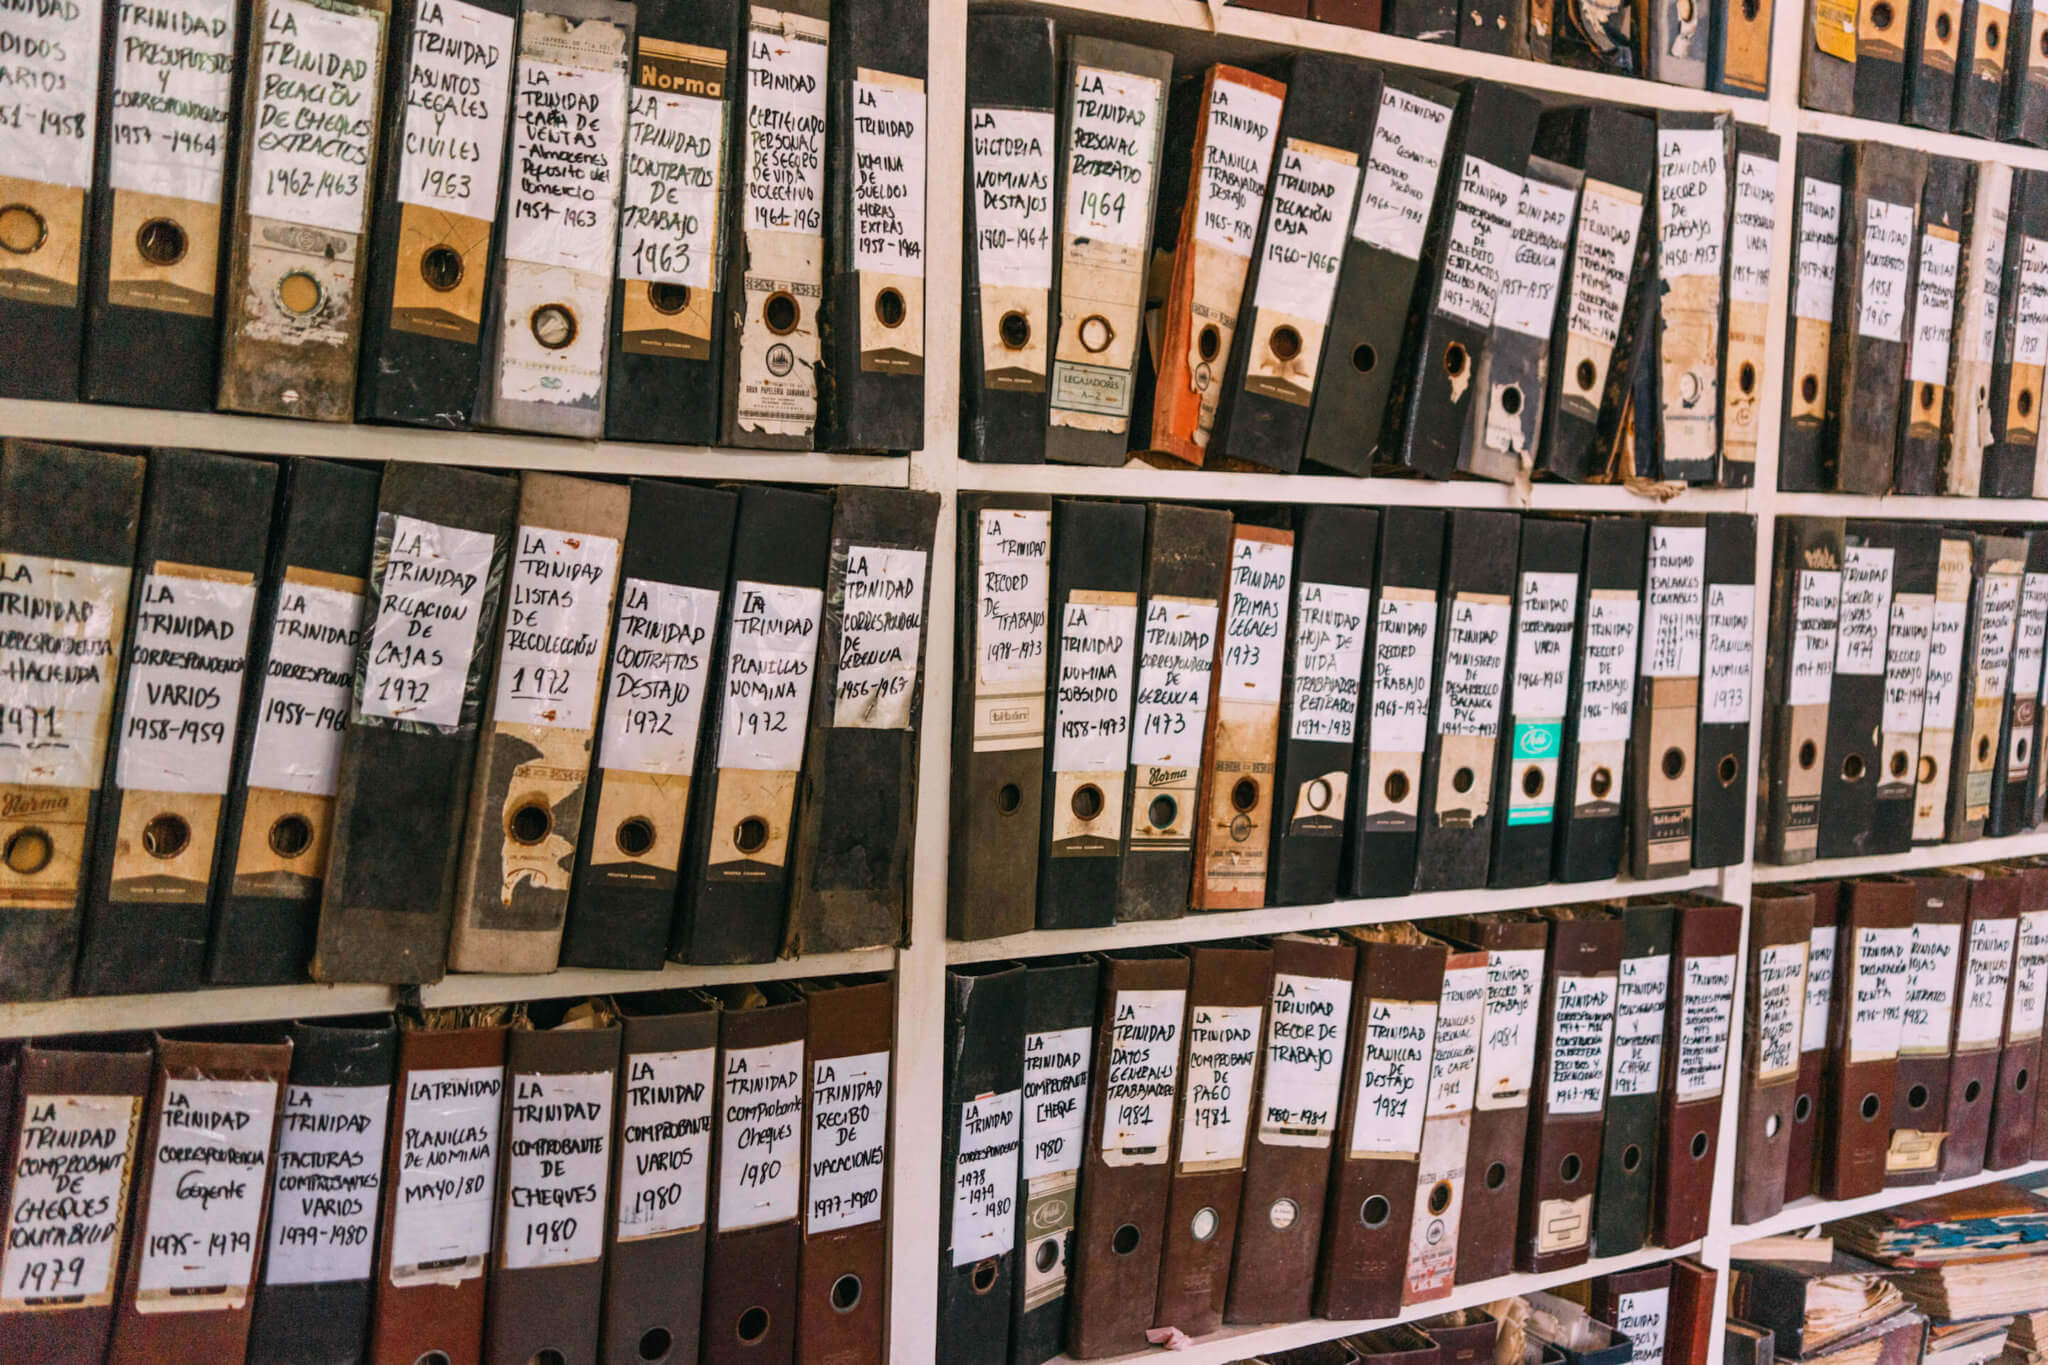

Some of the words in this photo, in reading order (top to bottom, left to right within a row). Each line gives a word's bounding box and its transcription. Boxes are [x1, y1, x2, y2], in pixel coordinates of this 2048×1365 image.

[413, 30, 500, 69] TRINIDAD
[263, 41, 368, 82] TRINIDAD
[158, 70, 171, 94] Y
[411, 64, 481, 97] ASUNTOS
[642, 65, 721, 97] Norma
[747, 69, 816, 93] TRINIDAD
[407, 89, 489, 120] LEGALES
[521, 90, 600, 112] TRINIDAD
[1212, 91, 1228, 105] LA
[259, 104, 288, 130] DE
[1077, 100, 1146, 126] TRINIDAD
[1400, 97, 1447, 124] TRINIDAD
[434, 112, 446, 137] Y
[855, 117, 914, 138] TRINIDAD
[1210, 110, 1268, 141] TRINIDAD
[405, 132, 481, 163] CIVILES
[527, 127, 597, 149] VENTAS
[631, 122, 712, 158] TRINIDAD
[752, 130, 818, 152] PERSONAL
[1663, 142, 1680, 158] LA
[627, 154, 713, 188] CONTRATOS
[1285, 156, 1302, 172] LA
[1661, 157, 1716, 178] TRINIDAD
[1741, 163, 1754, 177] LA
[421, 168, 472, 199] 1963
[976, 171, 1048, 190] NOMINAS
[1278, 173, 1335, 198] TRINIDAD
[1806, 183, 1817, 196] LA
[649, 181, 679, 204] DE
[1460, 179, 1508, 208] TRINIDAD
[1079, 190, 1126, 223] 1964
[1671, 203, 1688, 219] DE
[1869, 206, 1882, 219] LA
[623, 205, 699, 240] TRABAJO
[860, 221, 904, 237] EXTRAS
[632, 238, 690, 275] 1963
[1652, 535, 1667, 552] LA
[1845, 552, 1859, 564] LA
[388, 560, 477, 595] TRINIDAD
[520, 559, 603, 585] TRINIDAD
[985, 572, 1029, 592] RECORD
[1232, 565, 1286, 590] TRINIDAD
[1804, 575, 1815, 590] LA
[514, 584, 573, 608] LISTAS
[845, 578, 914, 600] TRINIDAD
[1306, 587, 1322, 602] LA
[1526, 581, 1538, 595] LA
[1711, 590, 1724, 606] LA
[984, 598, 1000, 617] DE
[1234, 592, 1279, 618] PRIMAS
[1525, 598, 1569, 613] TRINIDAD
[1592, 606, 1603, 618] LA
[1893, 604, 1905, 618] LA
[138, 611, 234, 641] TRINIDAD
[407, 620, 432, 638] DE
[512, 609, 537, 627] DE
[734, 618, 813, 638] TRINIDAD
[1227, 618, 1278, 638] LEGALES
[1302, 607, 1361, 631] TRINIDAD
[1379, 619, 1428, 639] TRINIDAD
[621, 615, 705, 645] TRINIDAD
[1147, 627, 1209, 650] TRINIDAD
[1449, 628, 1498, 645] TRINIDAD
[1589, 623, 1634, 638] TRINIDAD
[375, 640, 443, 669] CAJAS
[731, 654, 808, 676] PLANILLAS
[1226, 644, 1260, 666] 1973
[1304, 654, 1337, 671] VIDA
[1165, 671, 1181, 687] DE
[1377, 662, 1392, 677] DE
[1599, 662, 1611, 675] DE
[379, 677, 429, 703] 1972
[511, 667, 570, 694] 1972
[616, 673, 689, 707] DESTAJO
[730, 680, 796, 701] NOMINA
[1376, 676, 1425, 695] TRABAJO
[146, 682, 221, 710] VARIOS
[128, 716, 225, 744] 1958-1959
[625, 709, 673, 735] 1972
[737, 711, 787, 735] 1972
[1144, 712, 1186, 735] 1973
[1149, 767, 1188, 788] Norma
[1865, 933, 1877, 943] LA
[1973, 922, 1986, 935] LA
[1489, 955, 1502, 967] LA
[1687, 961, 1699, 971] LA
[1763, 950, 1777, 964] LA
[1488, 969, 1530, 982] TRINIDAD
[1623, 963, 1636, 976] LA
[1277, 981, 1295, 998] LA
[1561, 981, 1577, 994] LA
[1274, 1000, 1334, 1017] TRINIDAD
[1560, 992, 1608, 1009] TRINIDAD
[1196, 1012, 1212, 1024] LA
[1373, 1007, 1392, 1020] LA
[1113, 1024, 1176, 1043] TRINIDAD
[1192, 1028, 1251, 1043] TRINIDAD
[1318, 1023, 1337, 1041] DE
[1368, 1023, 1426, 1041] TRINIDAD
[1024, 1052, 1081, 1071] TRINIDAD
[1111, 1048, 1150, 1066] DATOS
[1270, 1044, 1333, 1072] TRABAJO
[1366, 1044, 1422, 1062] PLANILLAS
[1213, 1070, 1229, 1084] DE
[1389, 1062, 1404, 1077] DE
[726, 1071, 798, 1095] TRINIDAD
[815, 1079, 883, 1105] TRINIDAD
[1365, 1070, 1415, 1095] DESTAJO
[626, 1082, 705, 1107] TRINIDAD
[1193, 1084, 1231, 1104] PAGO
[513, 1102, 601, 1123] TRINIDAD
[1118, 1104, 1154, 1126] 1981
[1373, 1093, 1408, 1118] 1981
[162, 1110, 250, 1131] TRINIDAD
[284, 1112, 372, 1134] TRINIDAD
[816, 1104, 870, 1131] RECIBO
[965, 1110, 1014, 1135] TRINIDAD
[1195, 1105, 1231, 1129] 1981
[23, 1127, 117, 1150] TRINIDAD
[405, 1126, 489, 1150] PLANILLAS
[512, 1136, 604, 1157] COMPROBANTE
[835, 1126, 857, 1146] DE
[280, 1150, 364, 1170] FACTURAS
[404, 1152, 423, 1170] DE
[426, 1144, 491, 1168] NOMINA
[1035, 1137, 1065, 1161] 1980
[540, 1160, 566, 1178] DE
[636, 1147, 693, 1176] VARIOS
[813, 1145, 884, 1178] VACACIONES
[739, 1159, 782, 1188] 1980
[56, 1175, 85, 1195] DE
[511, 1183, 598, 1208] CHEQUES
[301, 1197, 363, 1218] VARIOS
[635, 1182, 682, 1214] 1980
[14, 1196, 110, 1224] CHEQUES
[279, 1225, 368, 1246] 1979-1980
[526, 1217, 578, 1246] 1980
[19, 1257, 85, 1292] 1979
